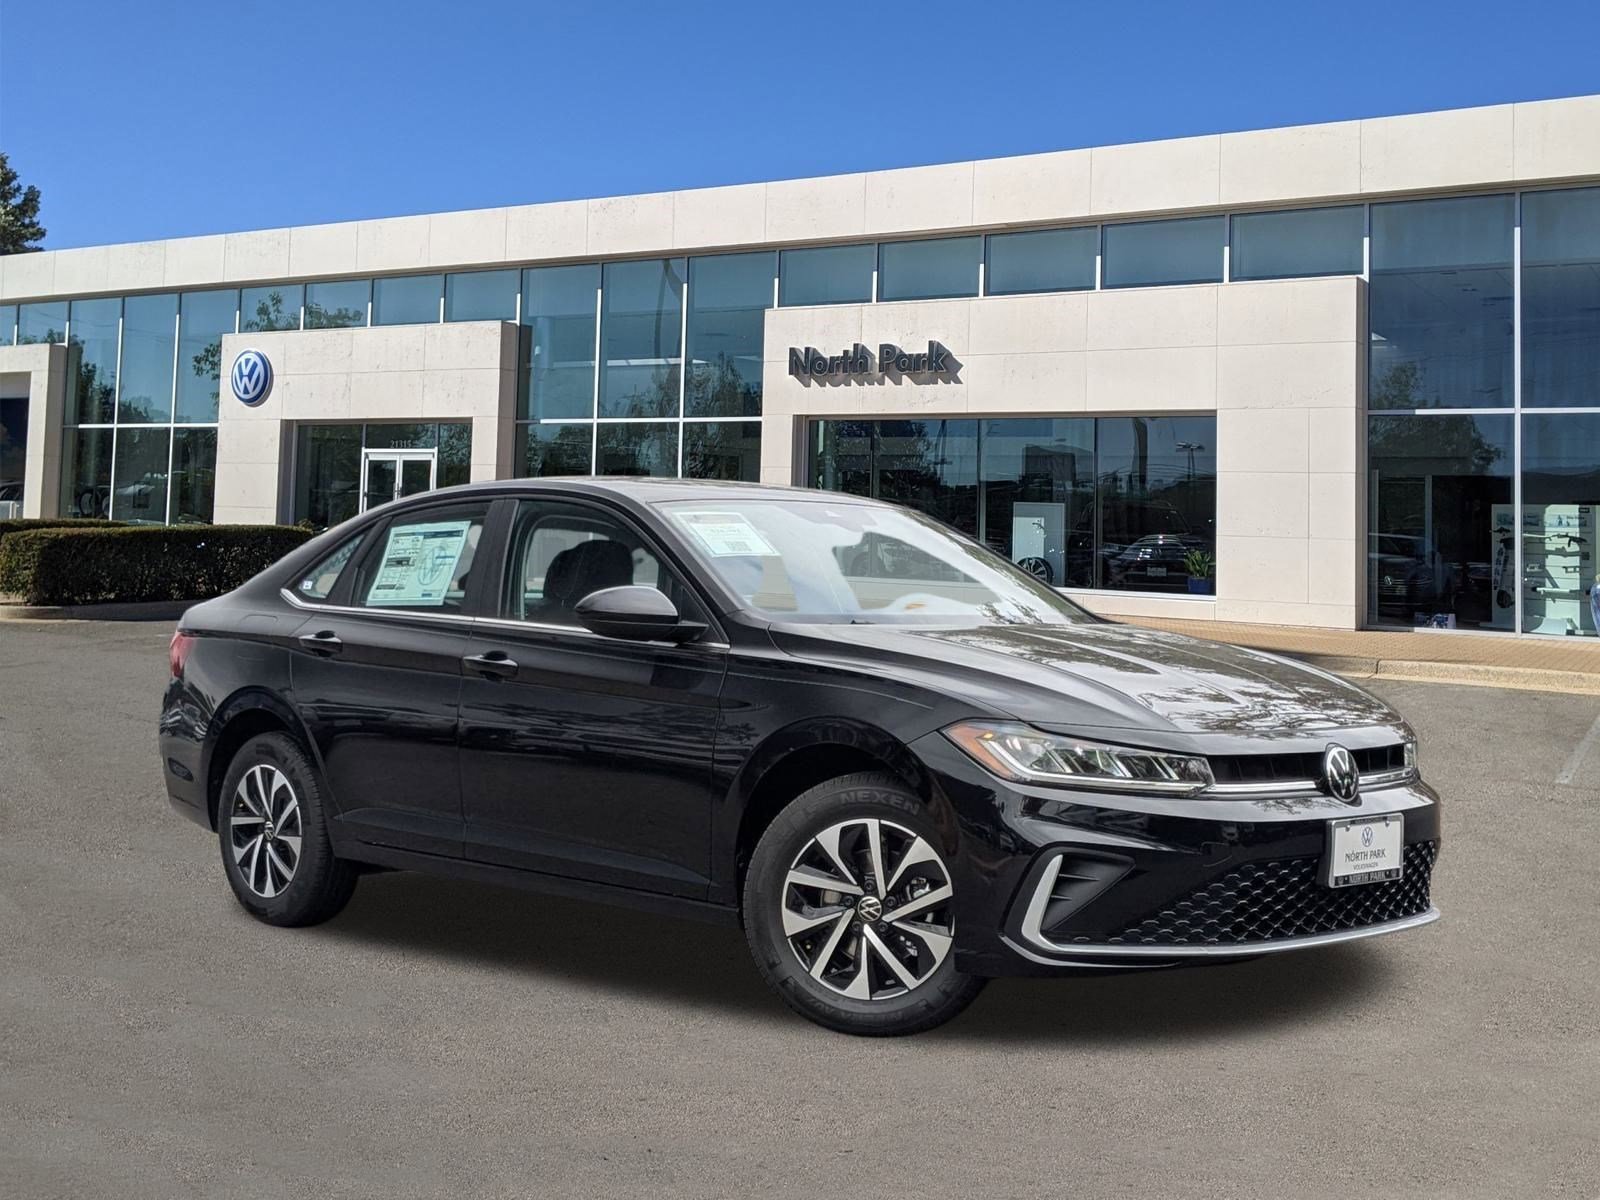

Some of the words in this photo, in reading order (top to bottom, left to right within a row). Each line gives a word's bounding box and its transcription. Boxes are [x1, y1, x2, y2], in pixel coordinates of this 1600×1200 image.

[788, 342, 869, 376] North
[878, 340, 949, 373] Park
[840, 790, 920, 816] NEXEN
[1344, 850, 1369, 863] NORTH
[1369, 848, 1386, 859] PARK
[1349, 873, 1369, 884] NORTH
[1369, 871, 1386, 882] PARK
